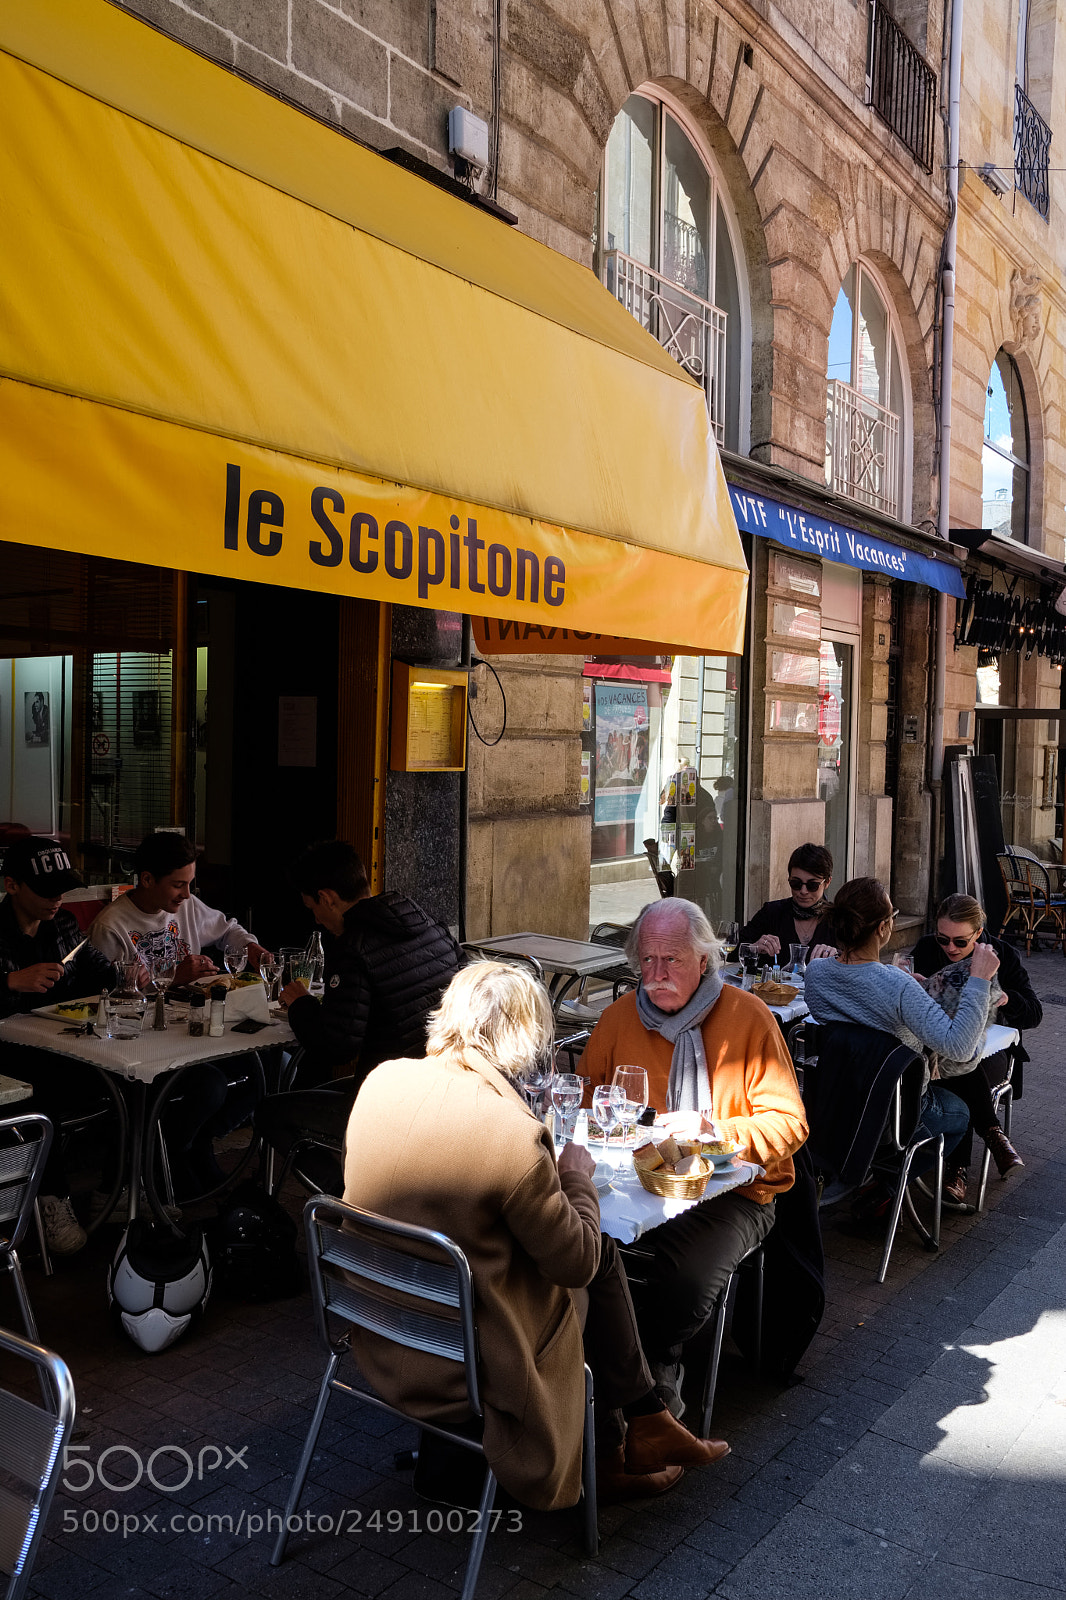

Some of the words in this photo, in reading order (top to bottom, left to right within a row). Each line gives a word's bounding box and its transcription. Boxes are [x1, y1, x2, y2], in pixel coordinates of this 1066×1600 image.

[224, 463, 285, 556] le
[308, 486, 566, 607] Scopitone
[735, 493, 767, 528] VTF
[846, 532, 907, 573] Vacances"
[31, 852, 71, 875] ICON
